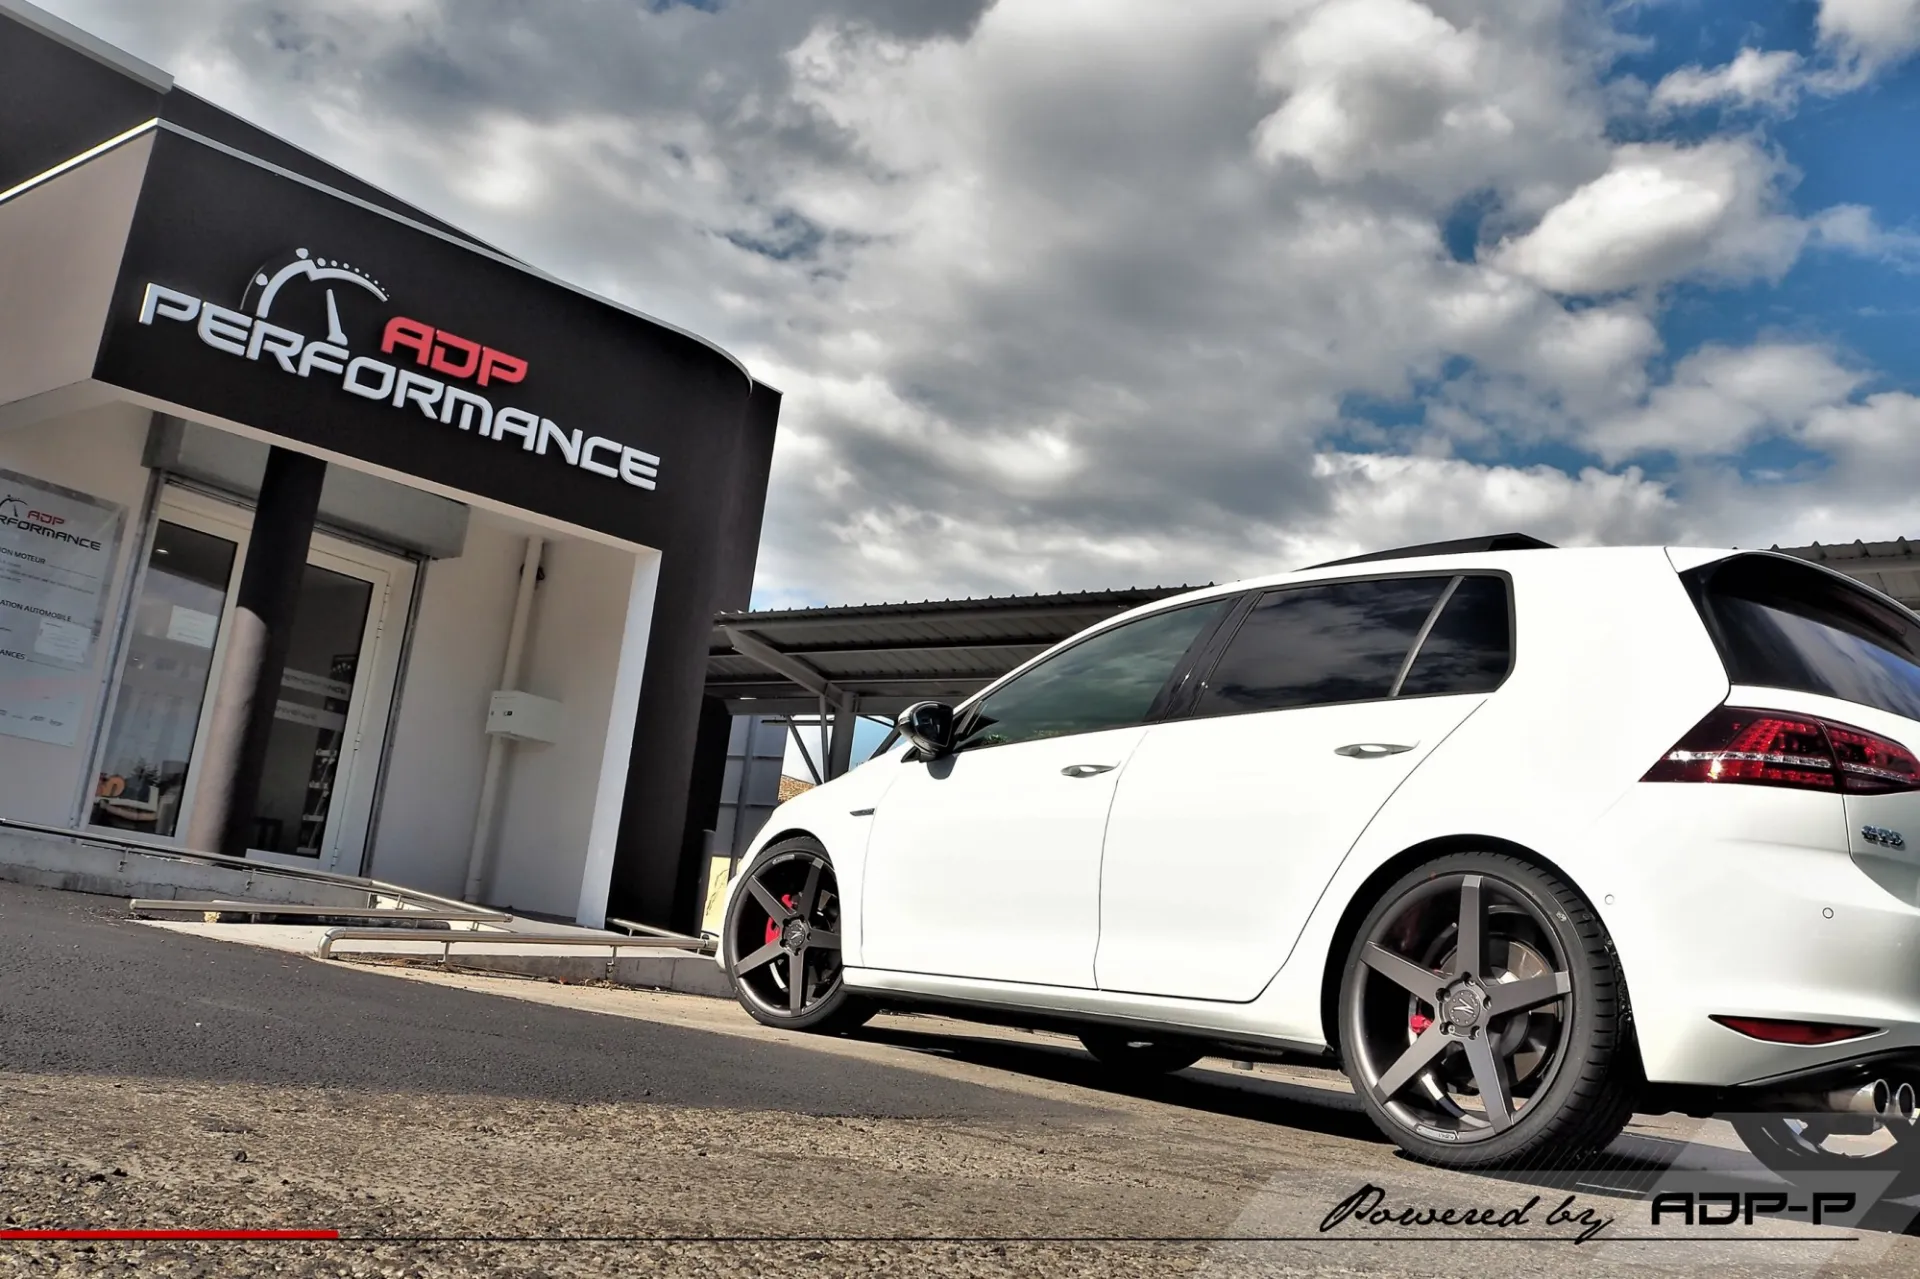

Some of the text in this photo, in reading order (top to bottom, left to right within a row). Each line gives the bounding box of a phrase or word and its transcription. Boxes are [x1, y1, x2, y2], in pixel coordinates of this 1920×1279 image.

[380, 316, 528, 387] ADP
[139, 282, 661, 491] PERFORMANCE
[27, 510, 65, 526] ADP
[14, 551, 46, 564] MOTEUR
[24, 605, 72, 623] AUTOMOBILE
